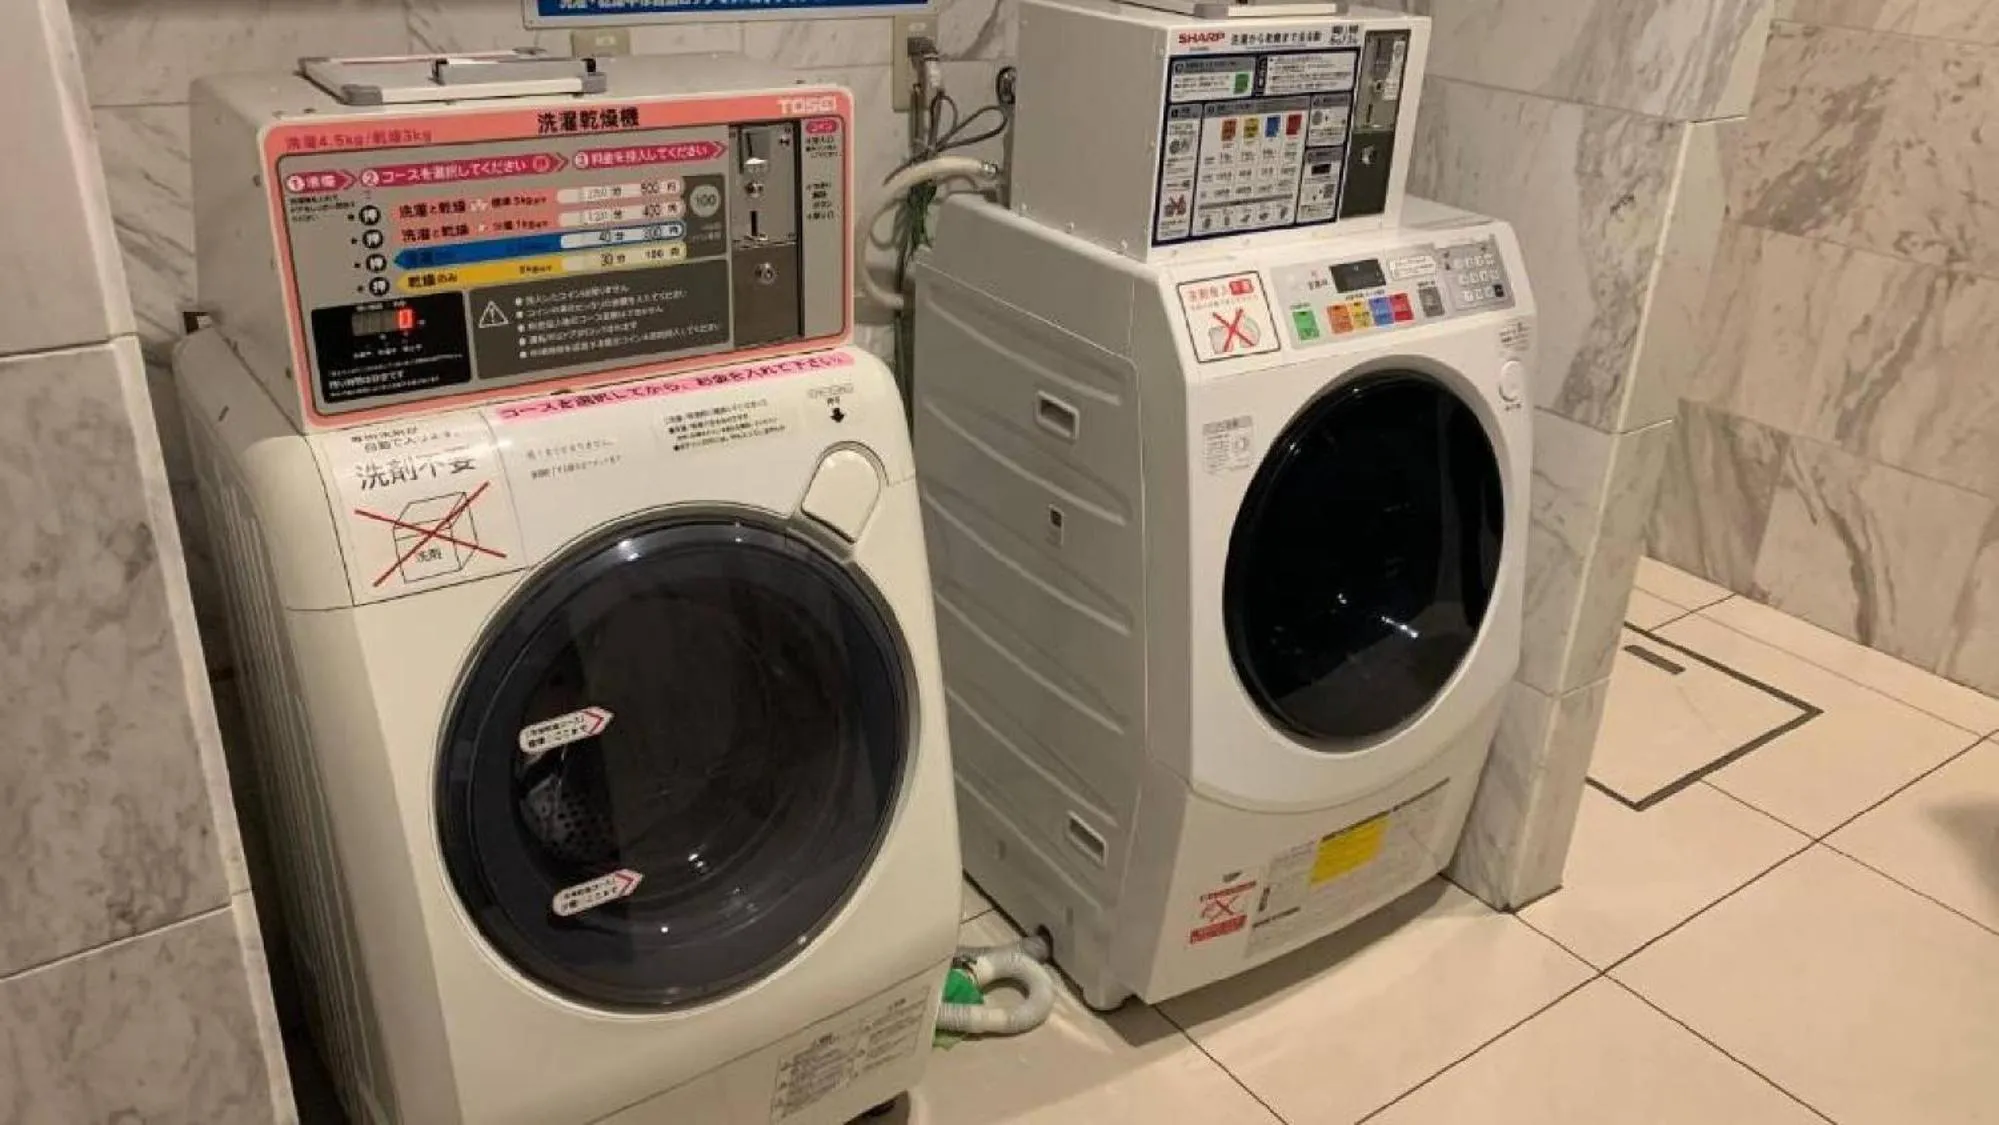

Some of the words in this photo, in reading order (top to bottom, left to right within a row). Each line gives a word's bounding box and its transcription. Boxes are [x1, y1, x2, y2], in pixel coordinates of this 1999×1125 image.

[1178, 31, 1226, 45] SHARP
[537, 106, 640, 134] 洗濯乾燥機
